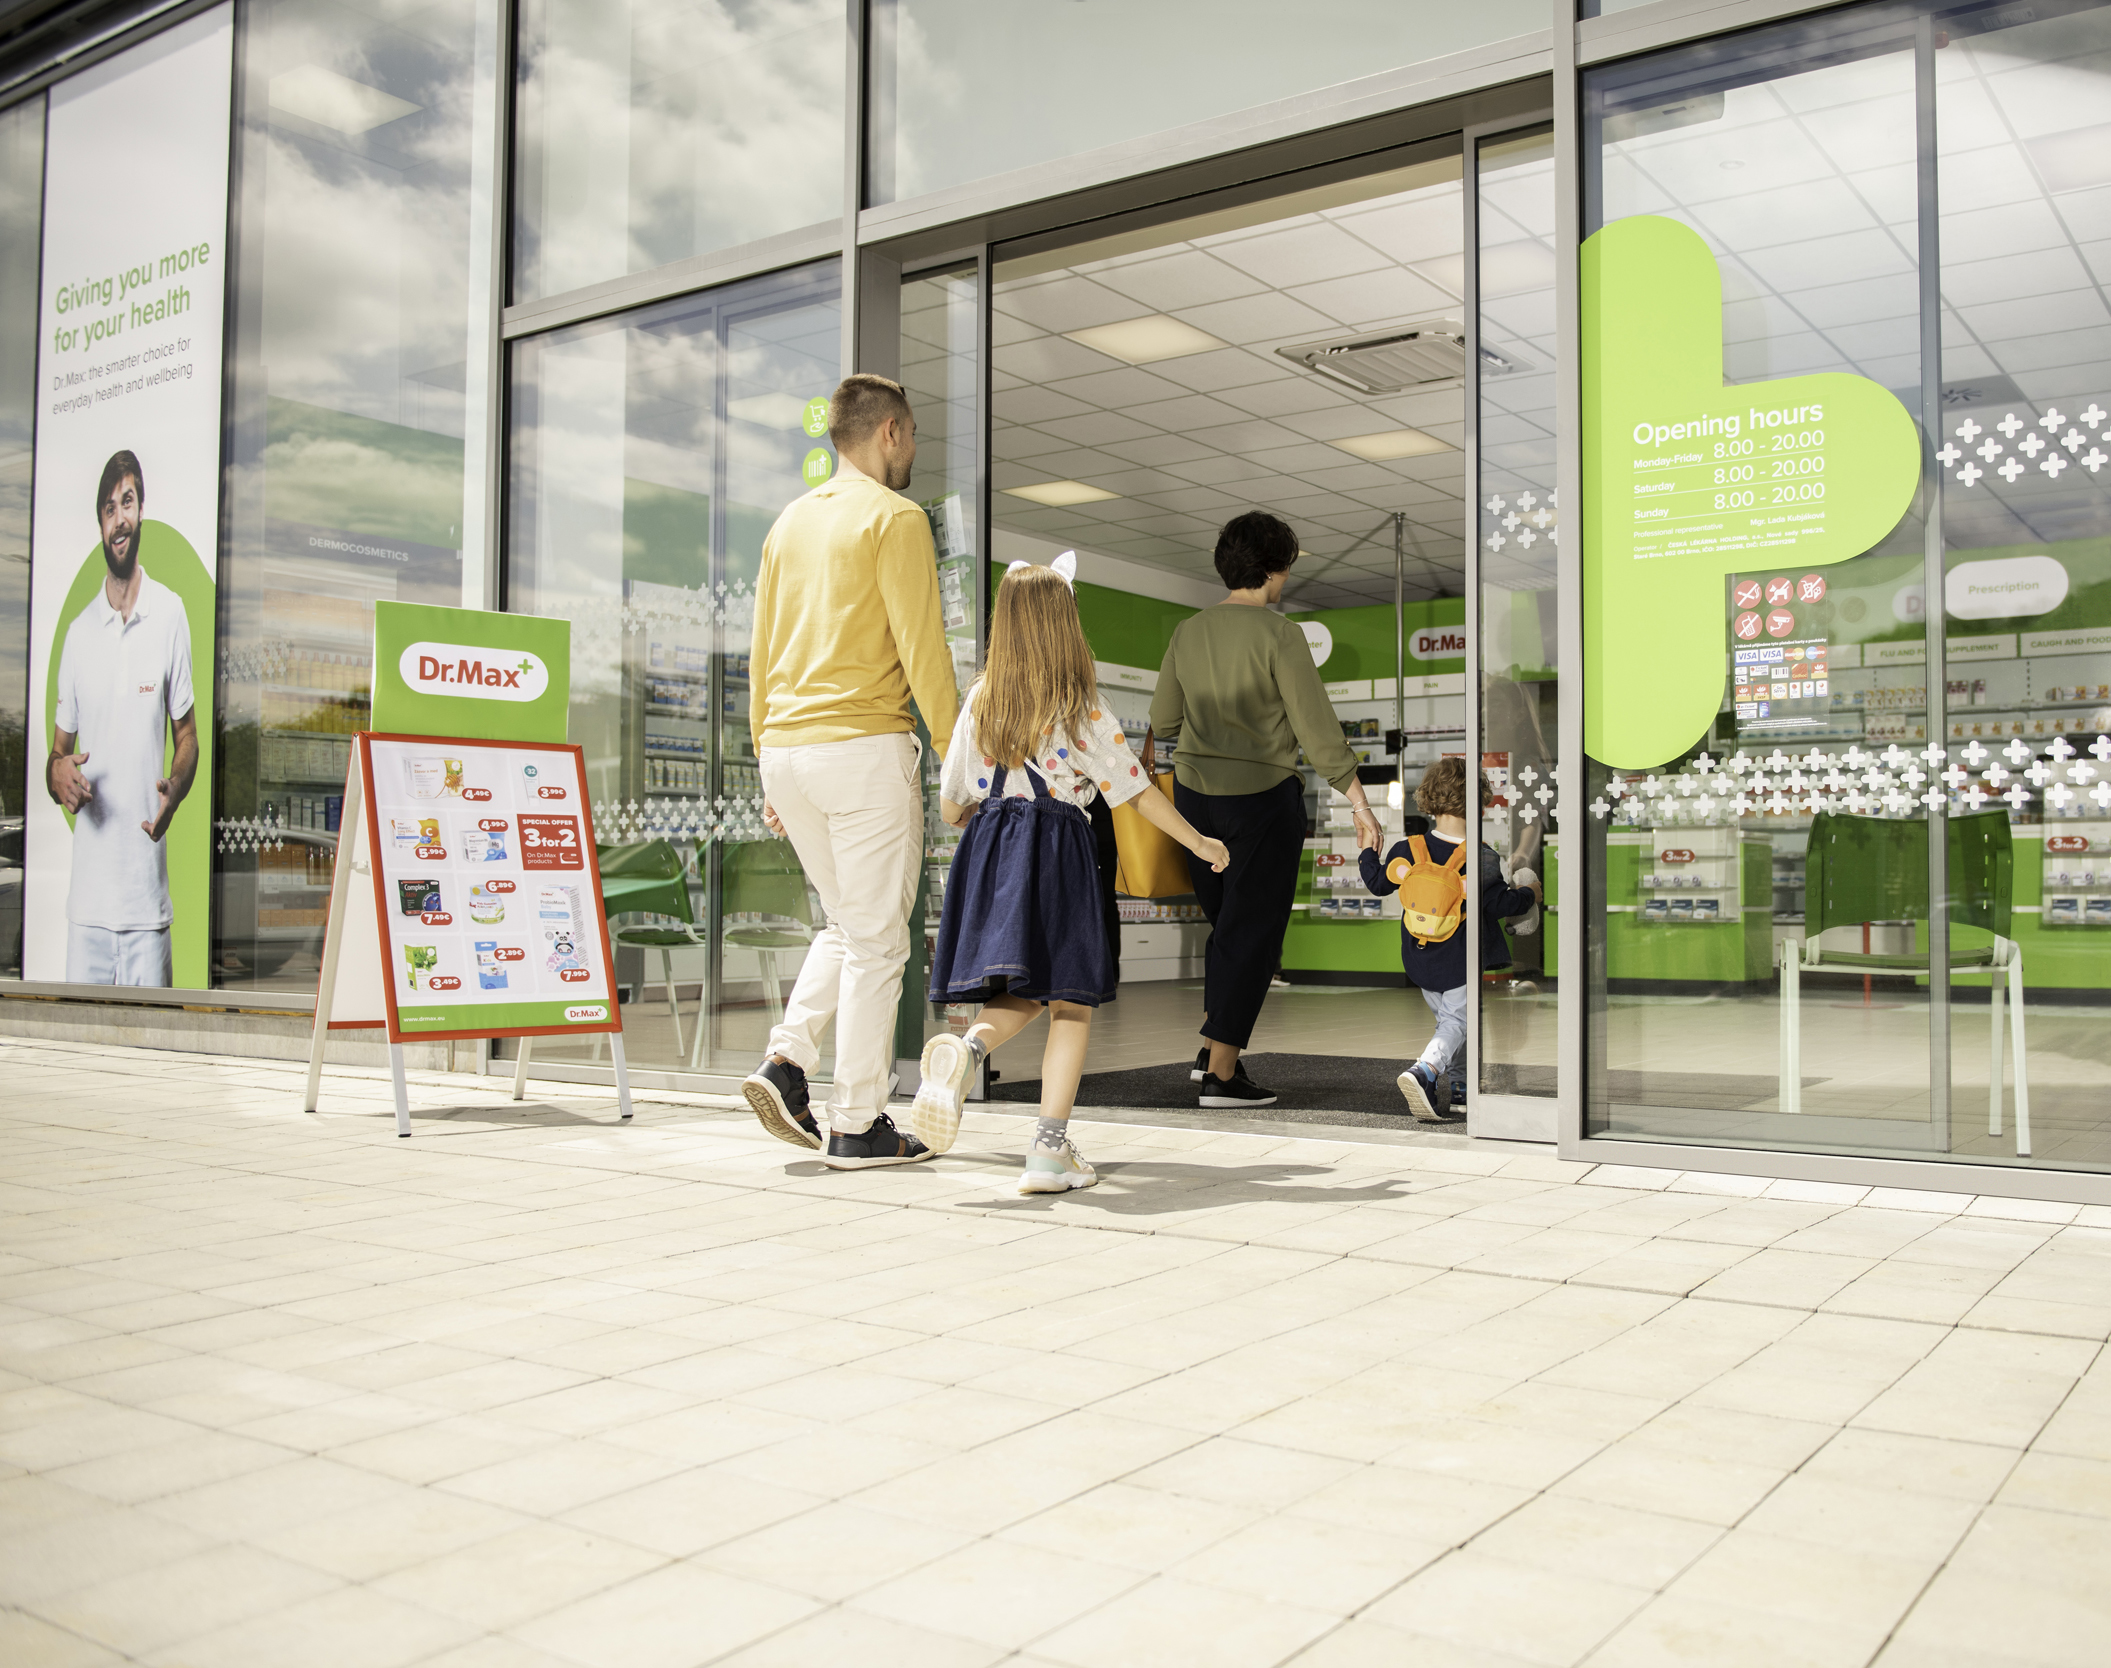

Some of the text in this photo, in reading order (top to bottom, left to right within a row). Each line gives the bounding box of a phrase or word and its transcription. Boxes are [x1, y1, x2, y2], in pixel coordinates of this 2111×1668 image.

[56, 242, 210, 314] Giving you more
[54, 285, 190, 354] for your health
[53, 337, 191, 391] Dr.Max: the smarter choice for
[53, 363, 193, 415] everyday health and wellbeing
[1633, 404, 1824, 448] Opening hours
[1633, 452, 1704, 469] Monday-Friday
[1713, 438, 1753, 459] 8.00
[1771, 430, 1824, 451] 20.00
[1633, 482, 1675, 494] Saturday
[1713, 465, 1754, 484] 8.00
[1771, 456, 1825, 478] 20.00
[1634, 508, 1669, 519] Sunday
[1714, 490, 1754, 510] 8.00
[1772, 482, 1825, 504] 20.00
[1633, 528, 1673, 538] Professional
[1675, 523, 1723, 534] representative
[1768, 516, 1785, 524] Lada
[1668, 540, 1687, 548] ČESKÁ
[1690, 538, 1717, 546] LÉKÁRNA
[309, 537, 409, 562] DERMOCOSMETICS
[1968, 580, 2040, 595] Prescription
[1419, 634, 1465, 653] Dr.Ma
[1739, 652, 1757, 660] VISA
[1763, 650, 1782, 658] VISA
[1897, 648, 1915, 656] AND
[419, 655, 521, 688] Dr.Max
[1120, 673, 1142, 682] IMMUNITY
[139, 685, 155, 693] Dr.Max
[1326, 688, 1349, 696] USCLES
[464, 789, 490, 800] 4.49€
[540, 788, 564, 798] 3.99€
[481, 820, 506, 831] 4.99€
[418, 848, 444, 858] 5.99€
[404, 884, 425, 892] Complex
[488, 881, 513, 892] 6.89€
[424, 913, 450, 924] 7.49€
[497, 949, 523, 960] 2.89€
[563, 970, 588, 981] 7.99€
[432, 978, 459, 989] 3.49€
[569, 1009, 600, 1018] Dr.Max
